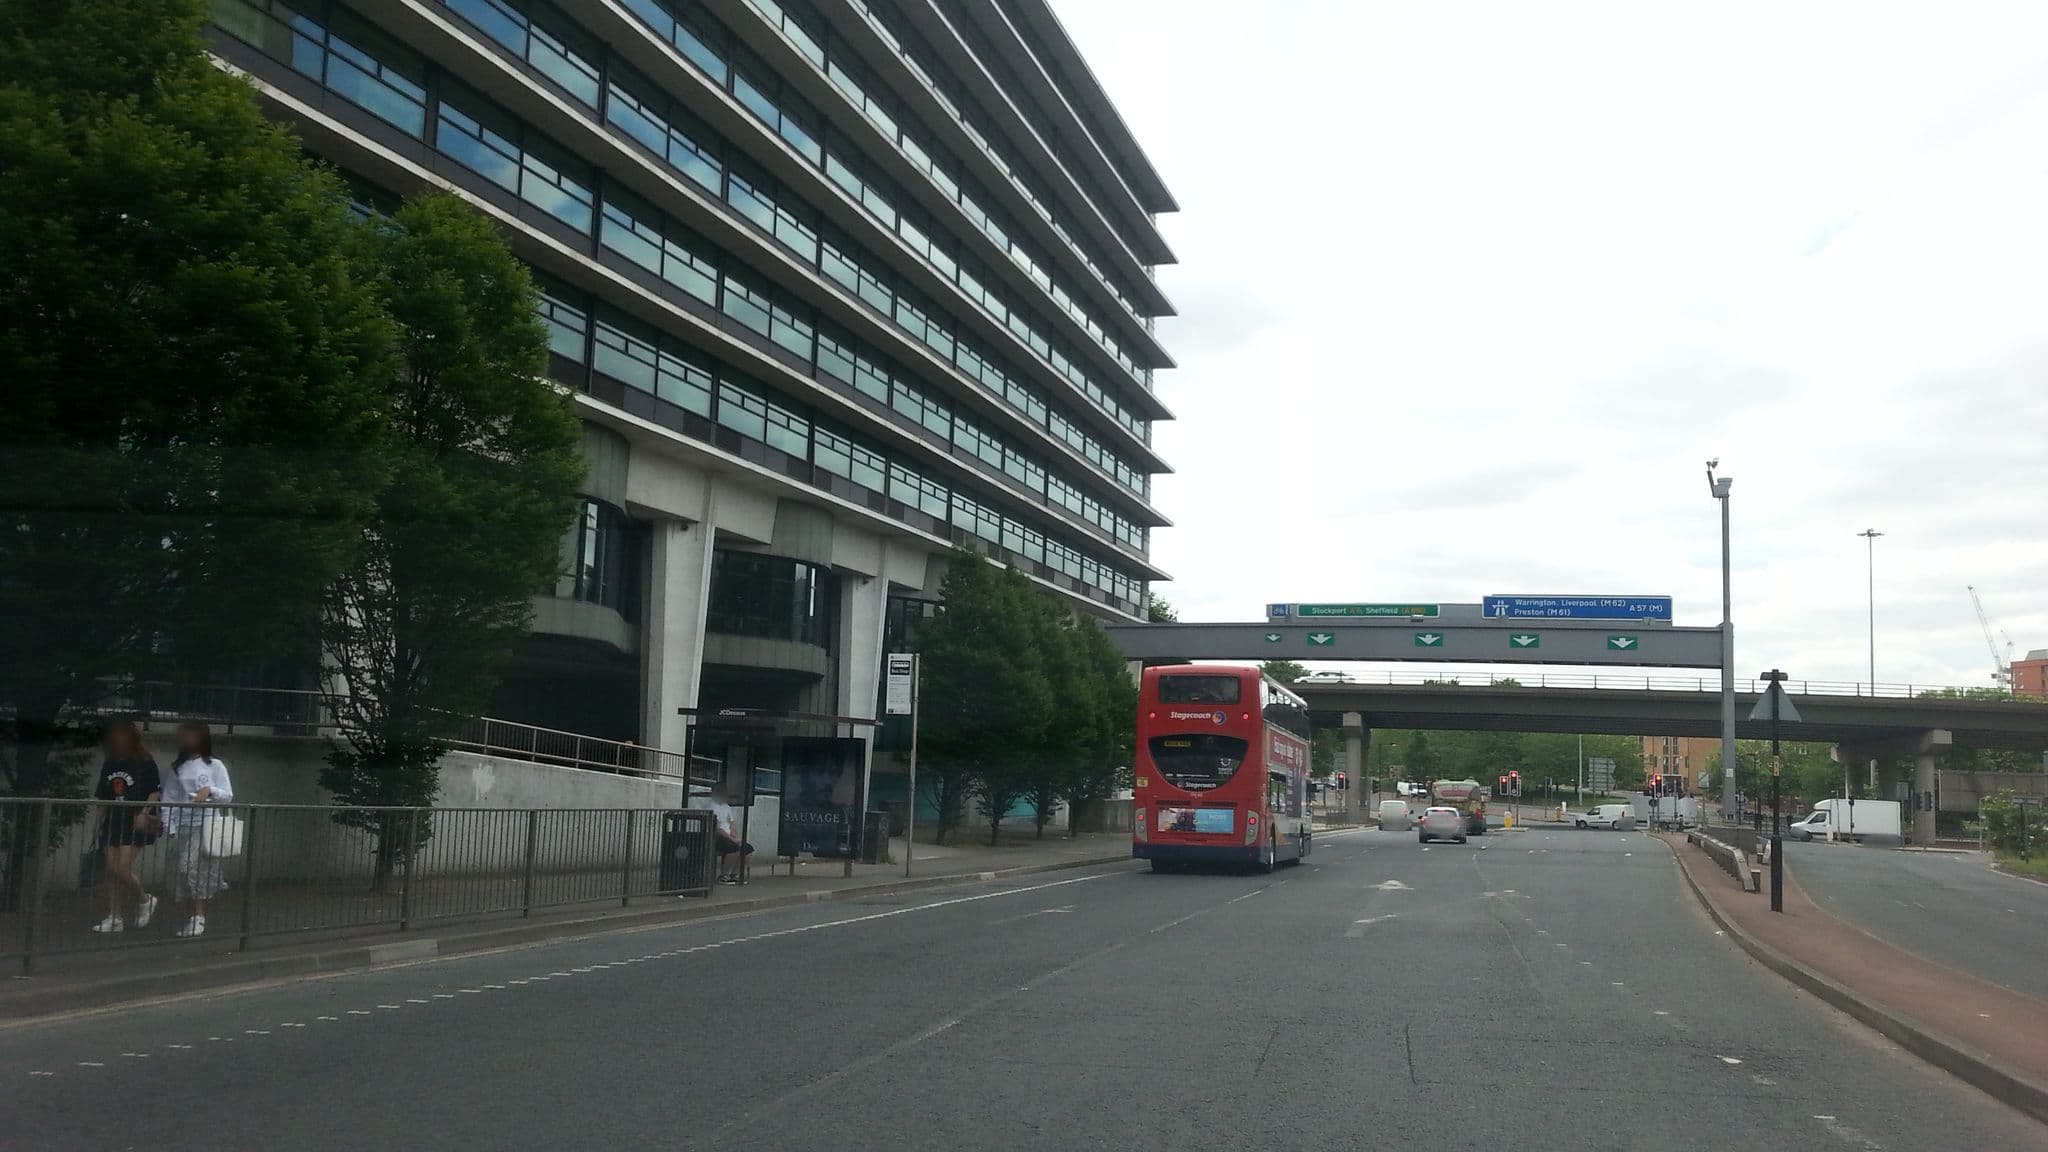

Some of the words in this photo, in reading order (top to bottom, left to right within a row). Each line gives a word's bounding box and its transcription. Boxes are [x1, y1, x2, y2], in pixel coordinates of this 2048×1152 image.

[1562, 599, 1597, 608] Liverpool
[1311, 607, 1346, 616] Stockport
[1365, 606, 1398, 614] Sheffield
[1514, 608, 1545, 616] Preston
[1170, 711, 1212, 721] Stagecoach
[1185, 781, 1217, 789] Stagecoach
[784, 812, 840, 824] SAUVAGE
